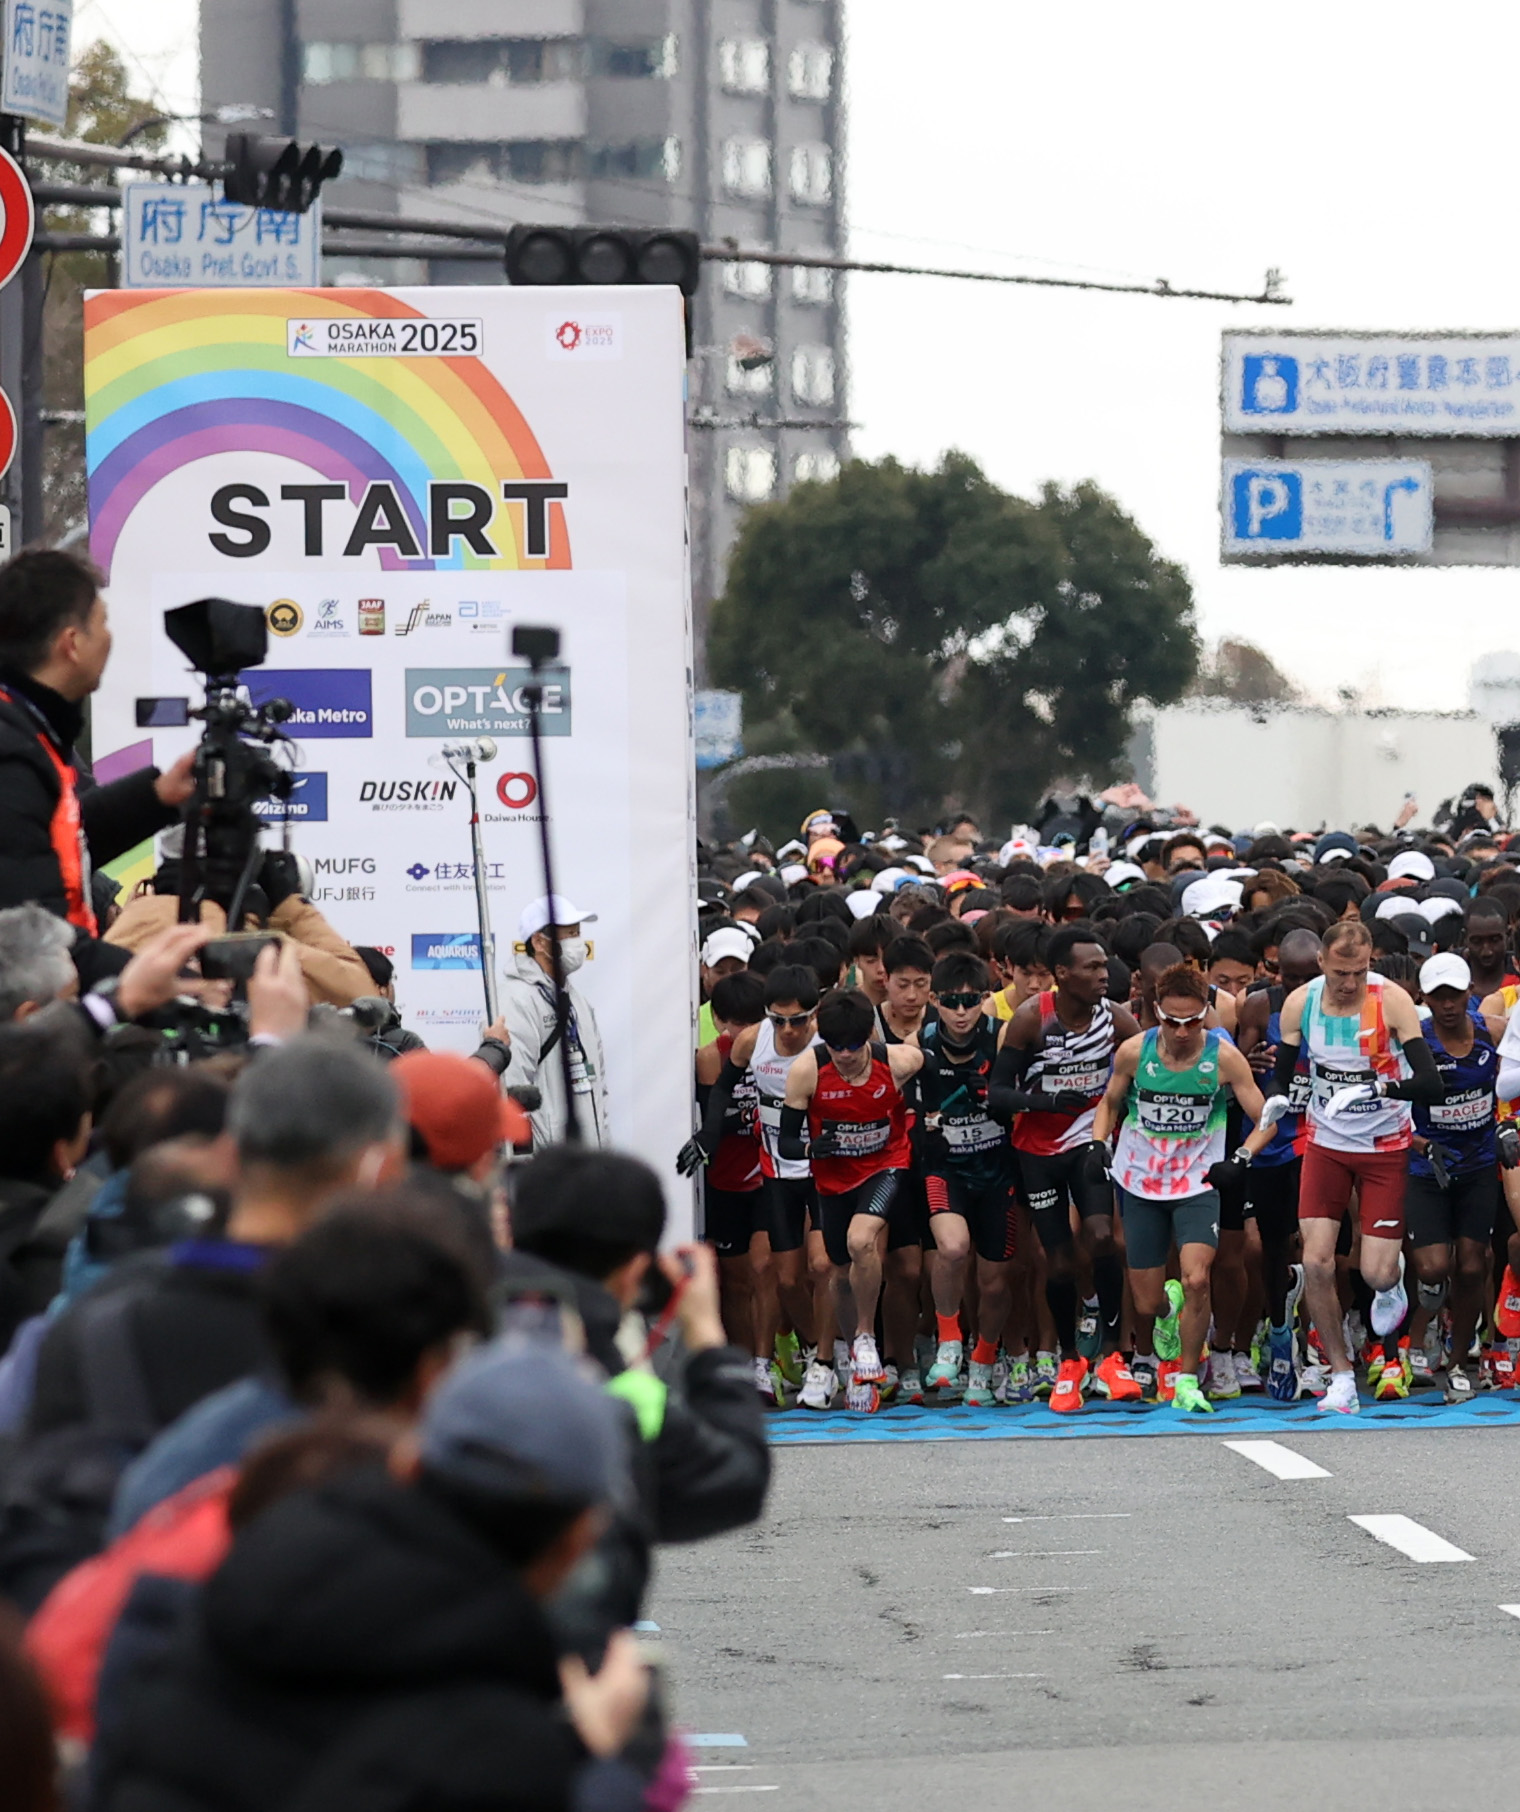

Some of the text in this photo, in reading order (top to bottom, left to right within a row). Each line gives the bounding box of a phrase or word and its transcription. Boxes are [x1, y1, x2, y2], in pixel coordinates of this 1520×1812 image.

[140, 197, 300, 244] 府庁南
[141, 252, 191, 277] Osaka
[327, 322, 478, 353] OSAKA 2025
[585, 327, 614, 337] EXPO
[327, 342, 397, 353] MARATHON
[585, 337, 614, 346] 2025
[208, 482, 568, 558] START
[361, 600, 382, 609] JAAF
[314, 619, 344, 630] AIMS
[318, 709, 367, 723] Metro
[447, 718, 530, 731] What's next?
[484, 814, 516, 823] Daiwa
[315, 858, 376, 874] MUFG
[405, 884, 461, 892] Connect with
[427, 945, 478, 959] AQUARIUS
[756, 1063, 783, 1075] FUJITSU
[1058, 1062, 1097, 1074] OPTAGE
[1053, 1074, 1100, 1088] PACE1
[1293, 1075, 1312, 1085] OPT
[1325, 1072, 1362, 1083] OPTAGE
[1153, 1094, 1194, 1106] OPTAGE
[1445, 1088, 1483, 1105] OPTAGE
[1441, 1099, 1488, 1119] PACE2
[949, 1114, 988, 1125] OPTAGE
[1151, 1108, 1194, 1123] 120
[837, 1123, 878, 1132] OPTAGE
[1437, 1113, 1495, 1131] Osaka Metro
[960, 1128, 982, 1139] 15
[949, 1139, 1002, 1154] saka Metro
